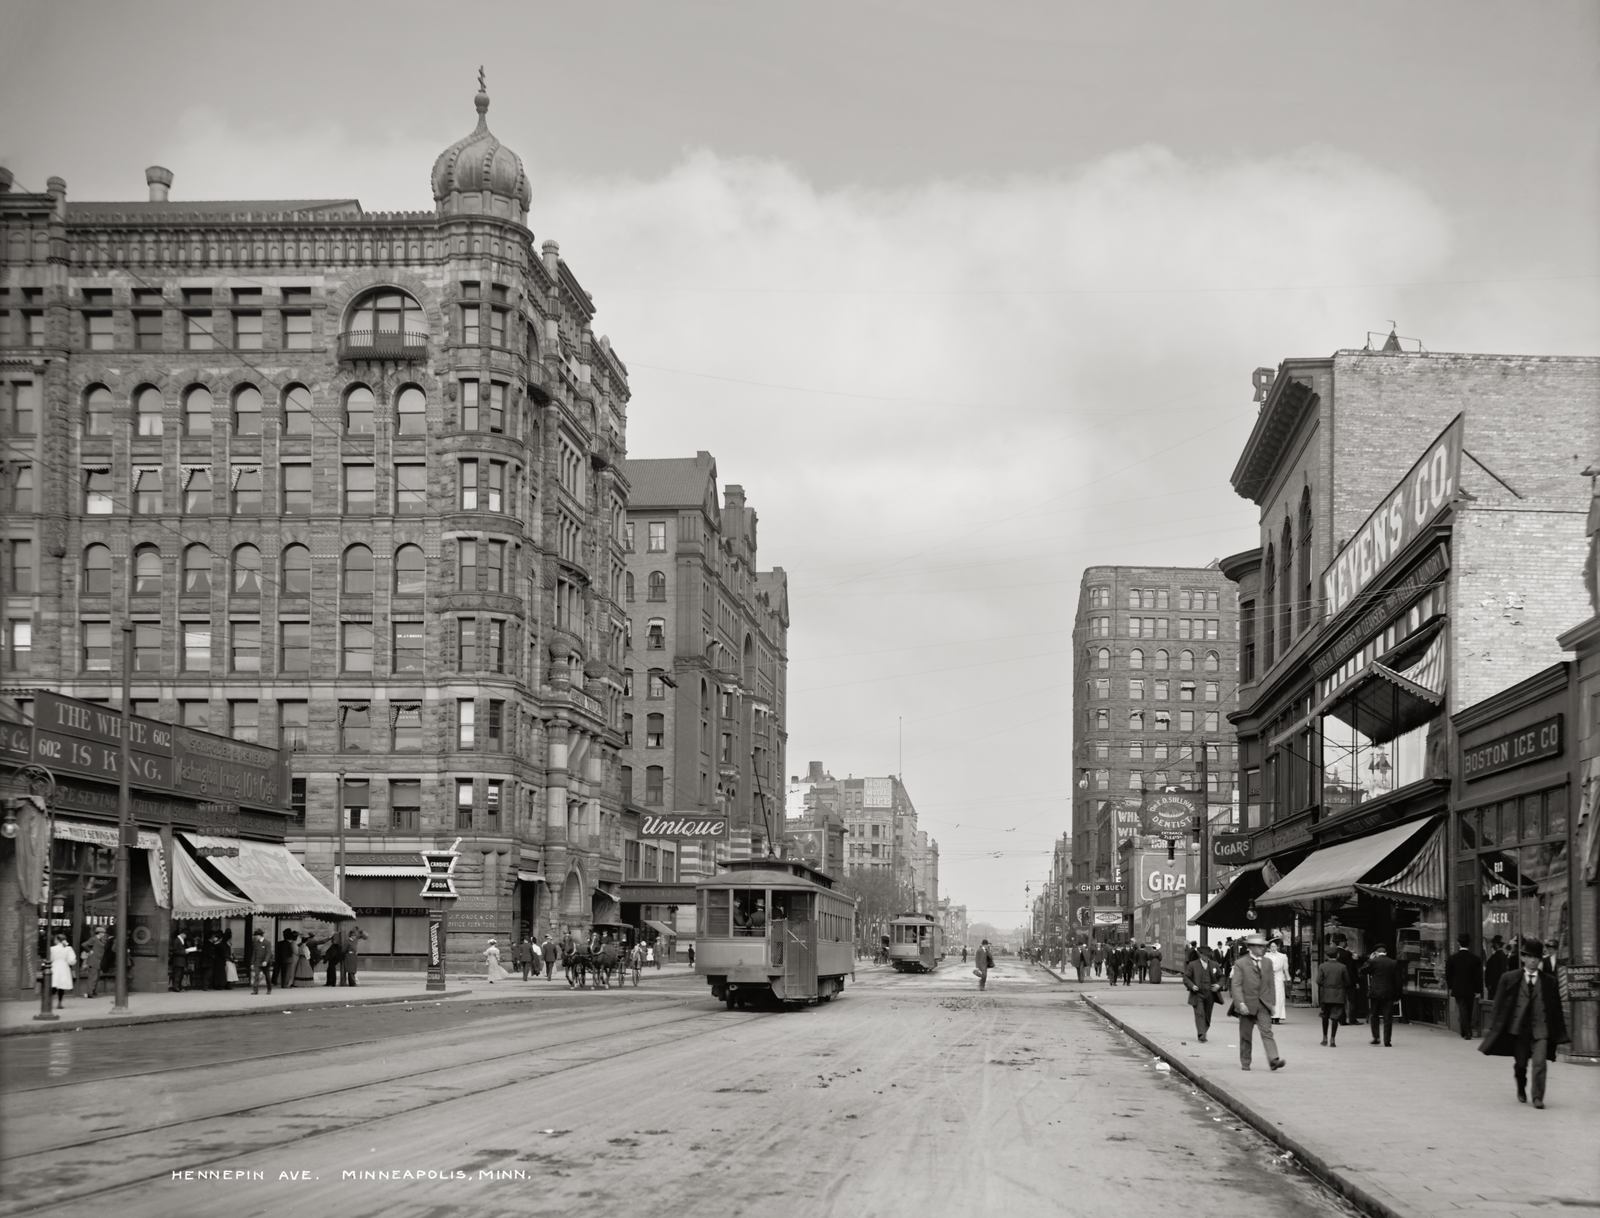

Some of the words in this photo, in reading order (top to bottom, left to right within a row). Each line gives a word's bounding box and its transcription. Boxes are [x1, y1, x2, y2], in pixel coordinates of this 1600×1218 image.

[1325, 491, 1403, 621] NEVENS
[1415, 444, 1453, 526] CO.
[1415, 551, 1441, 584] LAUNDRY
[55, 702, 91, 731] THE
[97, 712, 147, 744] WHTE
[153, 729, 171, 748] 602
[1465, 741, 1509, 774] BOSTON
[1514, 731, 1535, 759] ICE
[1541, 724, 1558, 749] CO
[38, 738, 61, 759] 602
[71, 743, 92, 767] IS
[103, 749, 162, 781] KNG.
[200, 804, 235, 812] WHITE
[1118, 811, 1141, 822] WHE
[199, 827, 238, 835] SEWING
[641, 816, 725, 837] Unique
[1118, 828, 1138, 837] WIL
[1151, 839, 1186, 849] HORAN
[1214, 841, 1250, 857] CIGARS
[1149, 871, 1186, 891] GRA
[85, 916, 115, 926] WHITE
